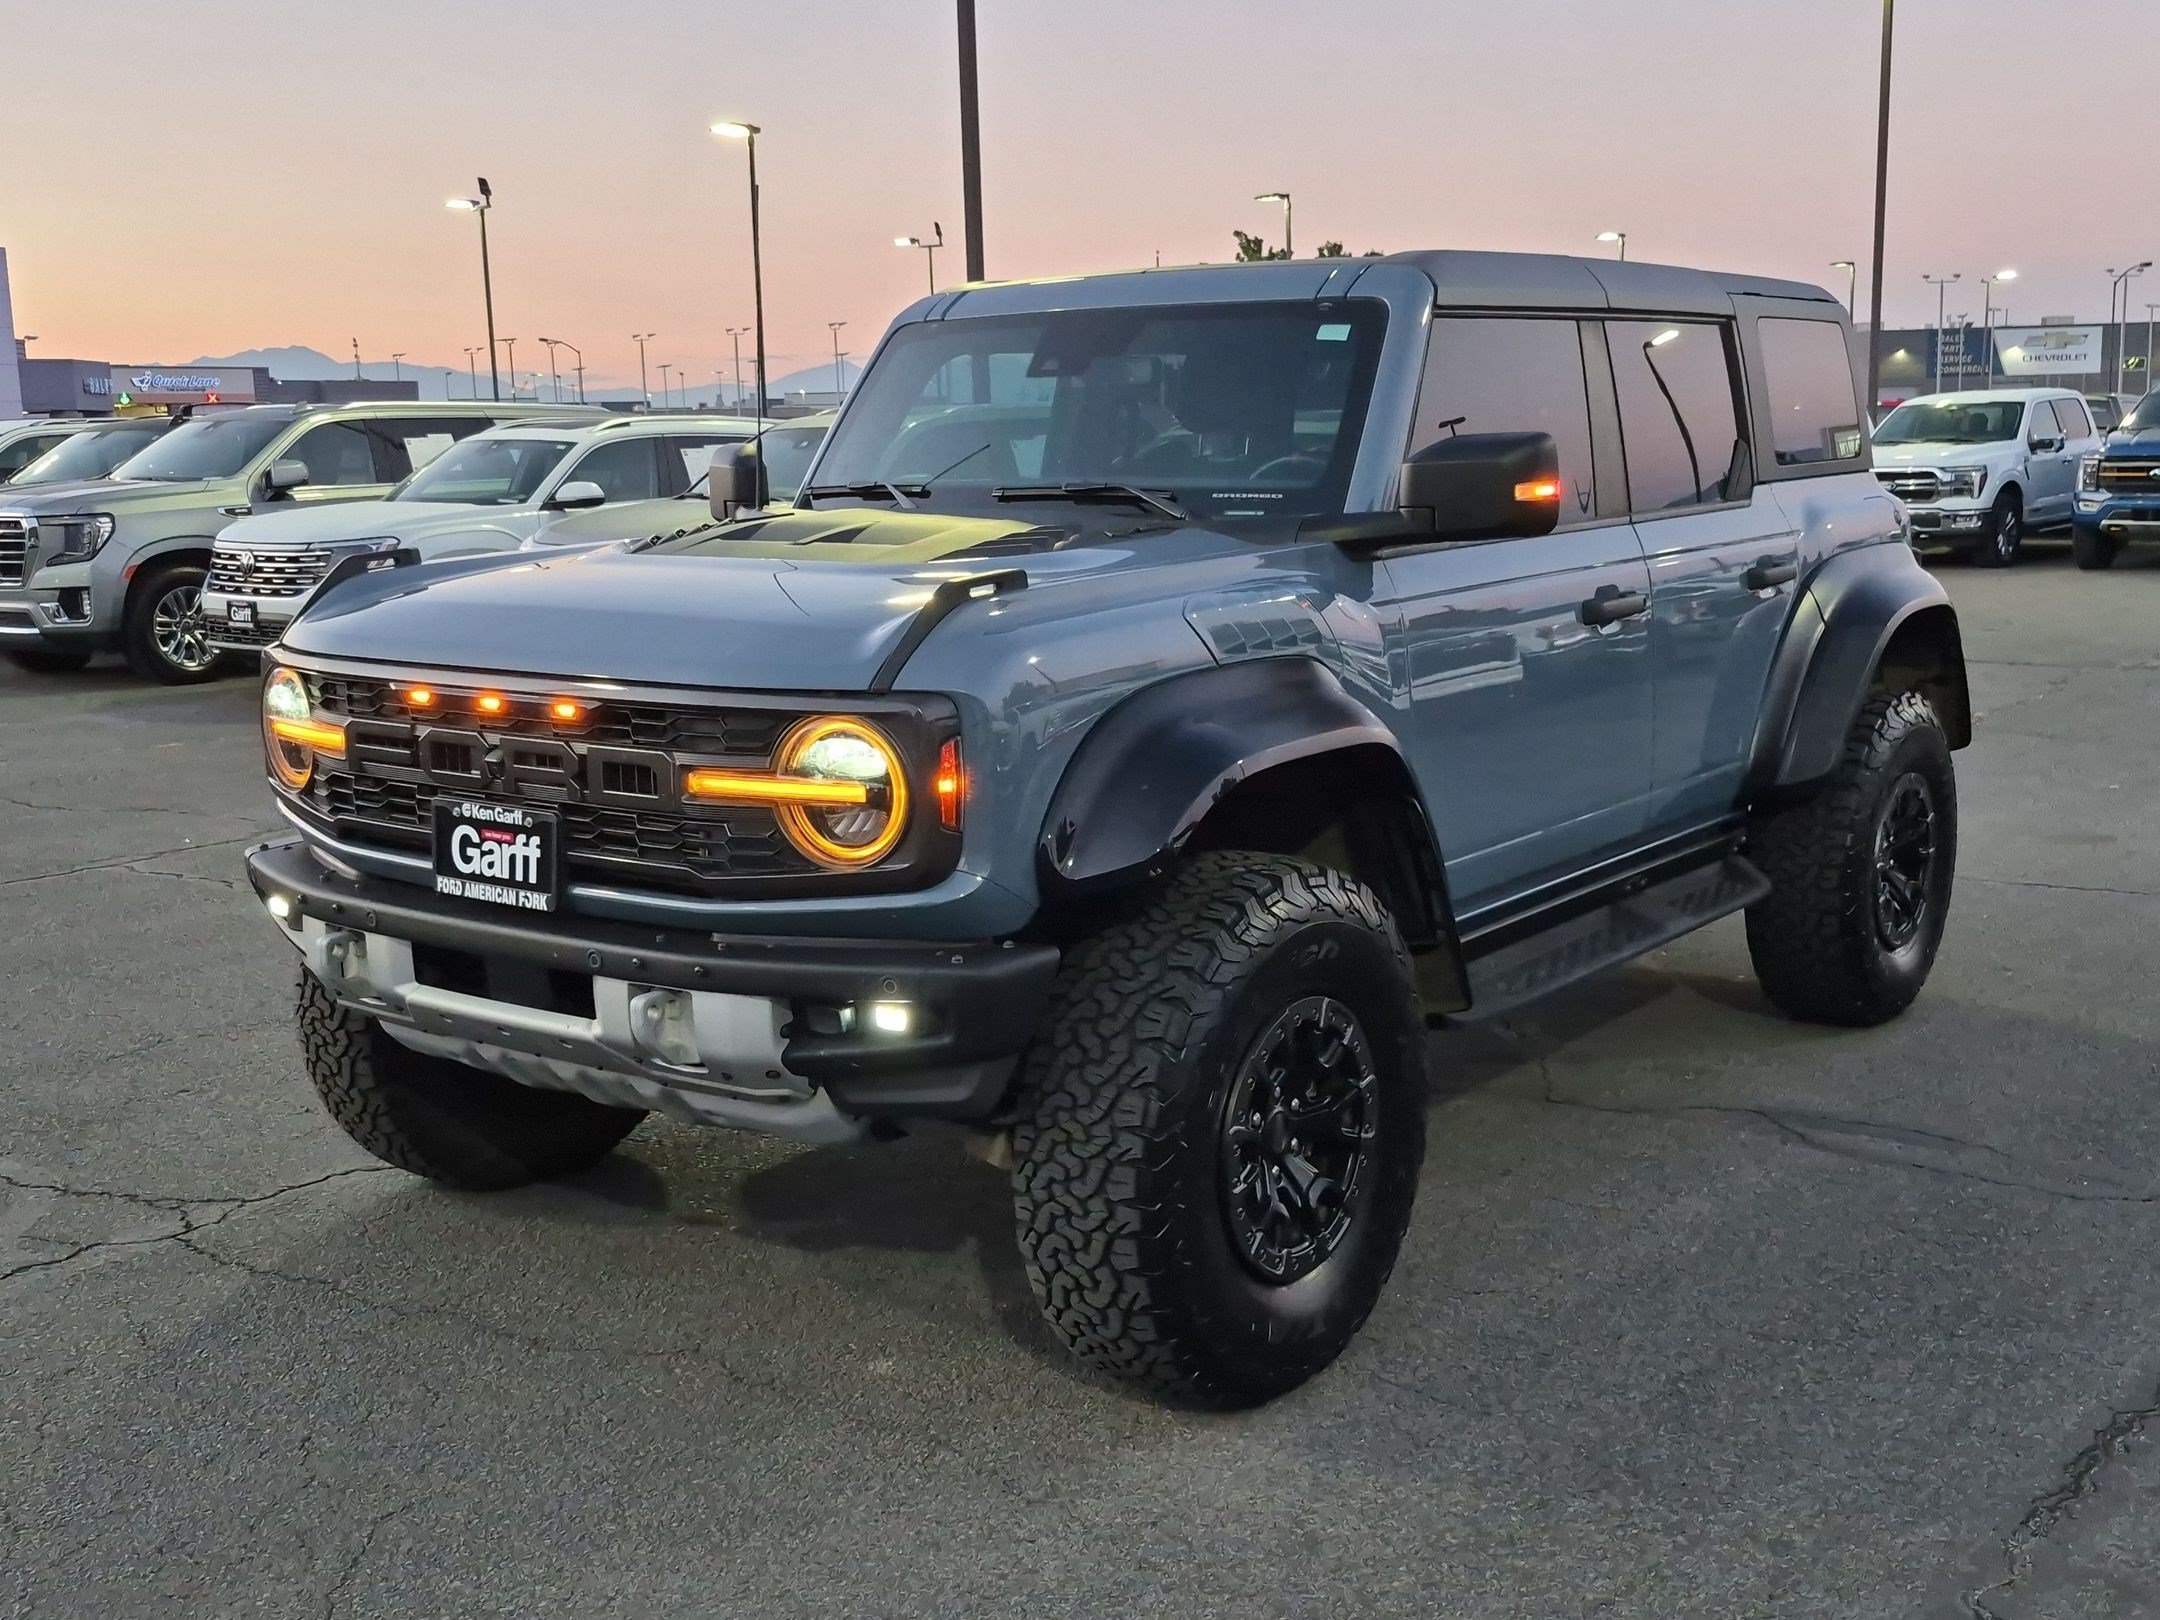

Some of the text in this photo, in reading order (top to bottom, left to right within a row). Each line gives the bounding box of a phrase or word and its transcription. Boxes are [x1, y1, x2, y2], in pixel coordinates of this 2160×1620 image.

[2022, 353, 2088, 363] CHEVROLET
[152, 374, 221, 388] Quick Lane
[471, 804, 523, 825] Ken Garff
[451, 824, 541, 884] Garff
[437, 877, 548, 911] FORD AMERICAN FORK
